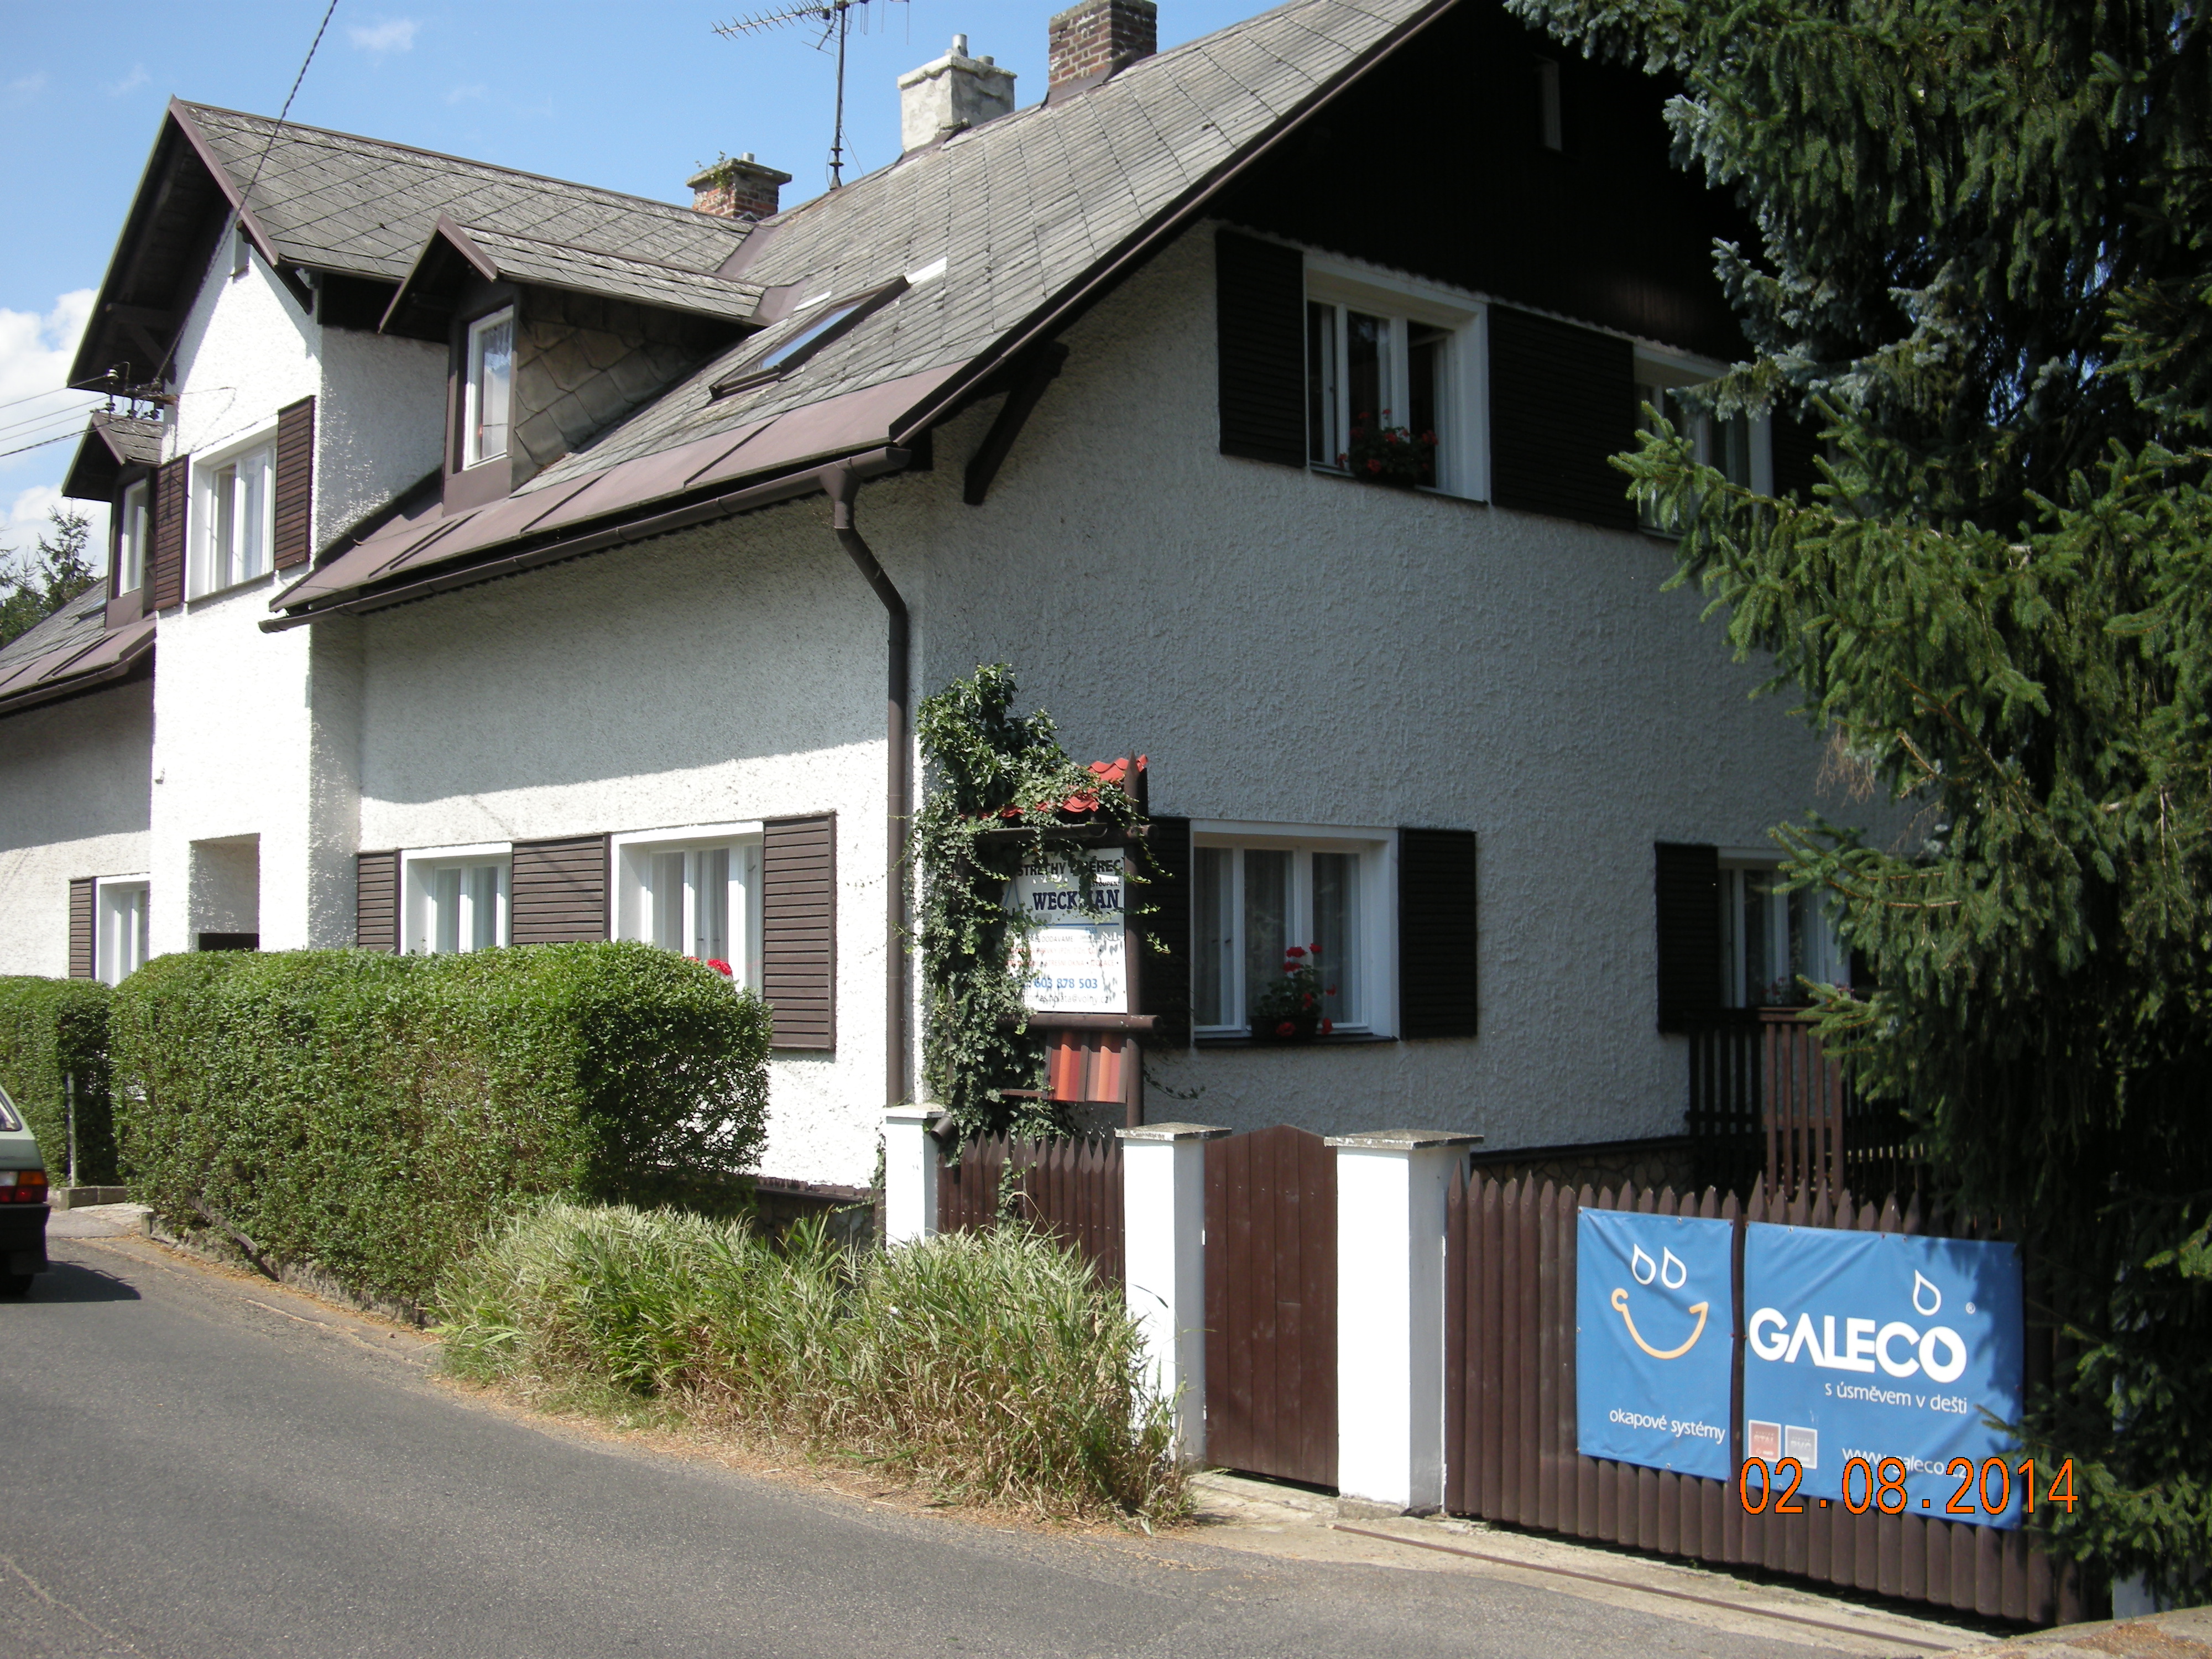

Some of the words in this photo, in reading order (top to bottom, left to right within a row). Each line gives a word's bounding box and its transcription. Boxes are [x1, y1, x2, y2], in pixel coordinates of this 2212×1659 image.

[1032, 889, 1120, 911] WECKAN
[1034, 977, 1052, 989] 603
[1057, 978, 1075, 989] 878
[1079, 978, 1098, 989] 503
[1749, 1307, 1967, 1383] GALECO
[1824, 1383, 1832, 1396] s
[1837, 1381, 1911, 1407] úsměvem
[1916, 1394, 1926, 1408] v
[1930, 1394, 1968, 1415] dešti
[1609, 1408, 1667, 1431] okapové
[1671, 1420, 1726, 1444] systémy
[1842, 1447, 1968, 1480] wwwalecoz
